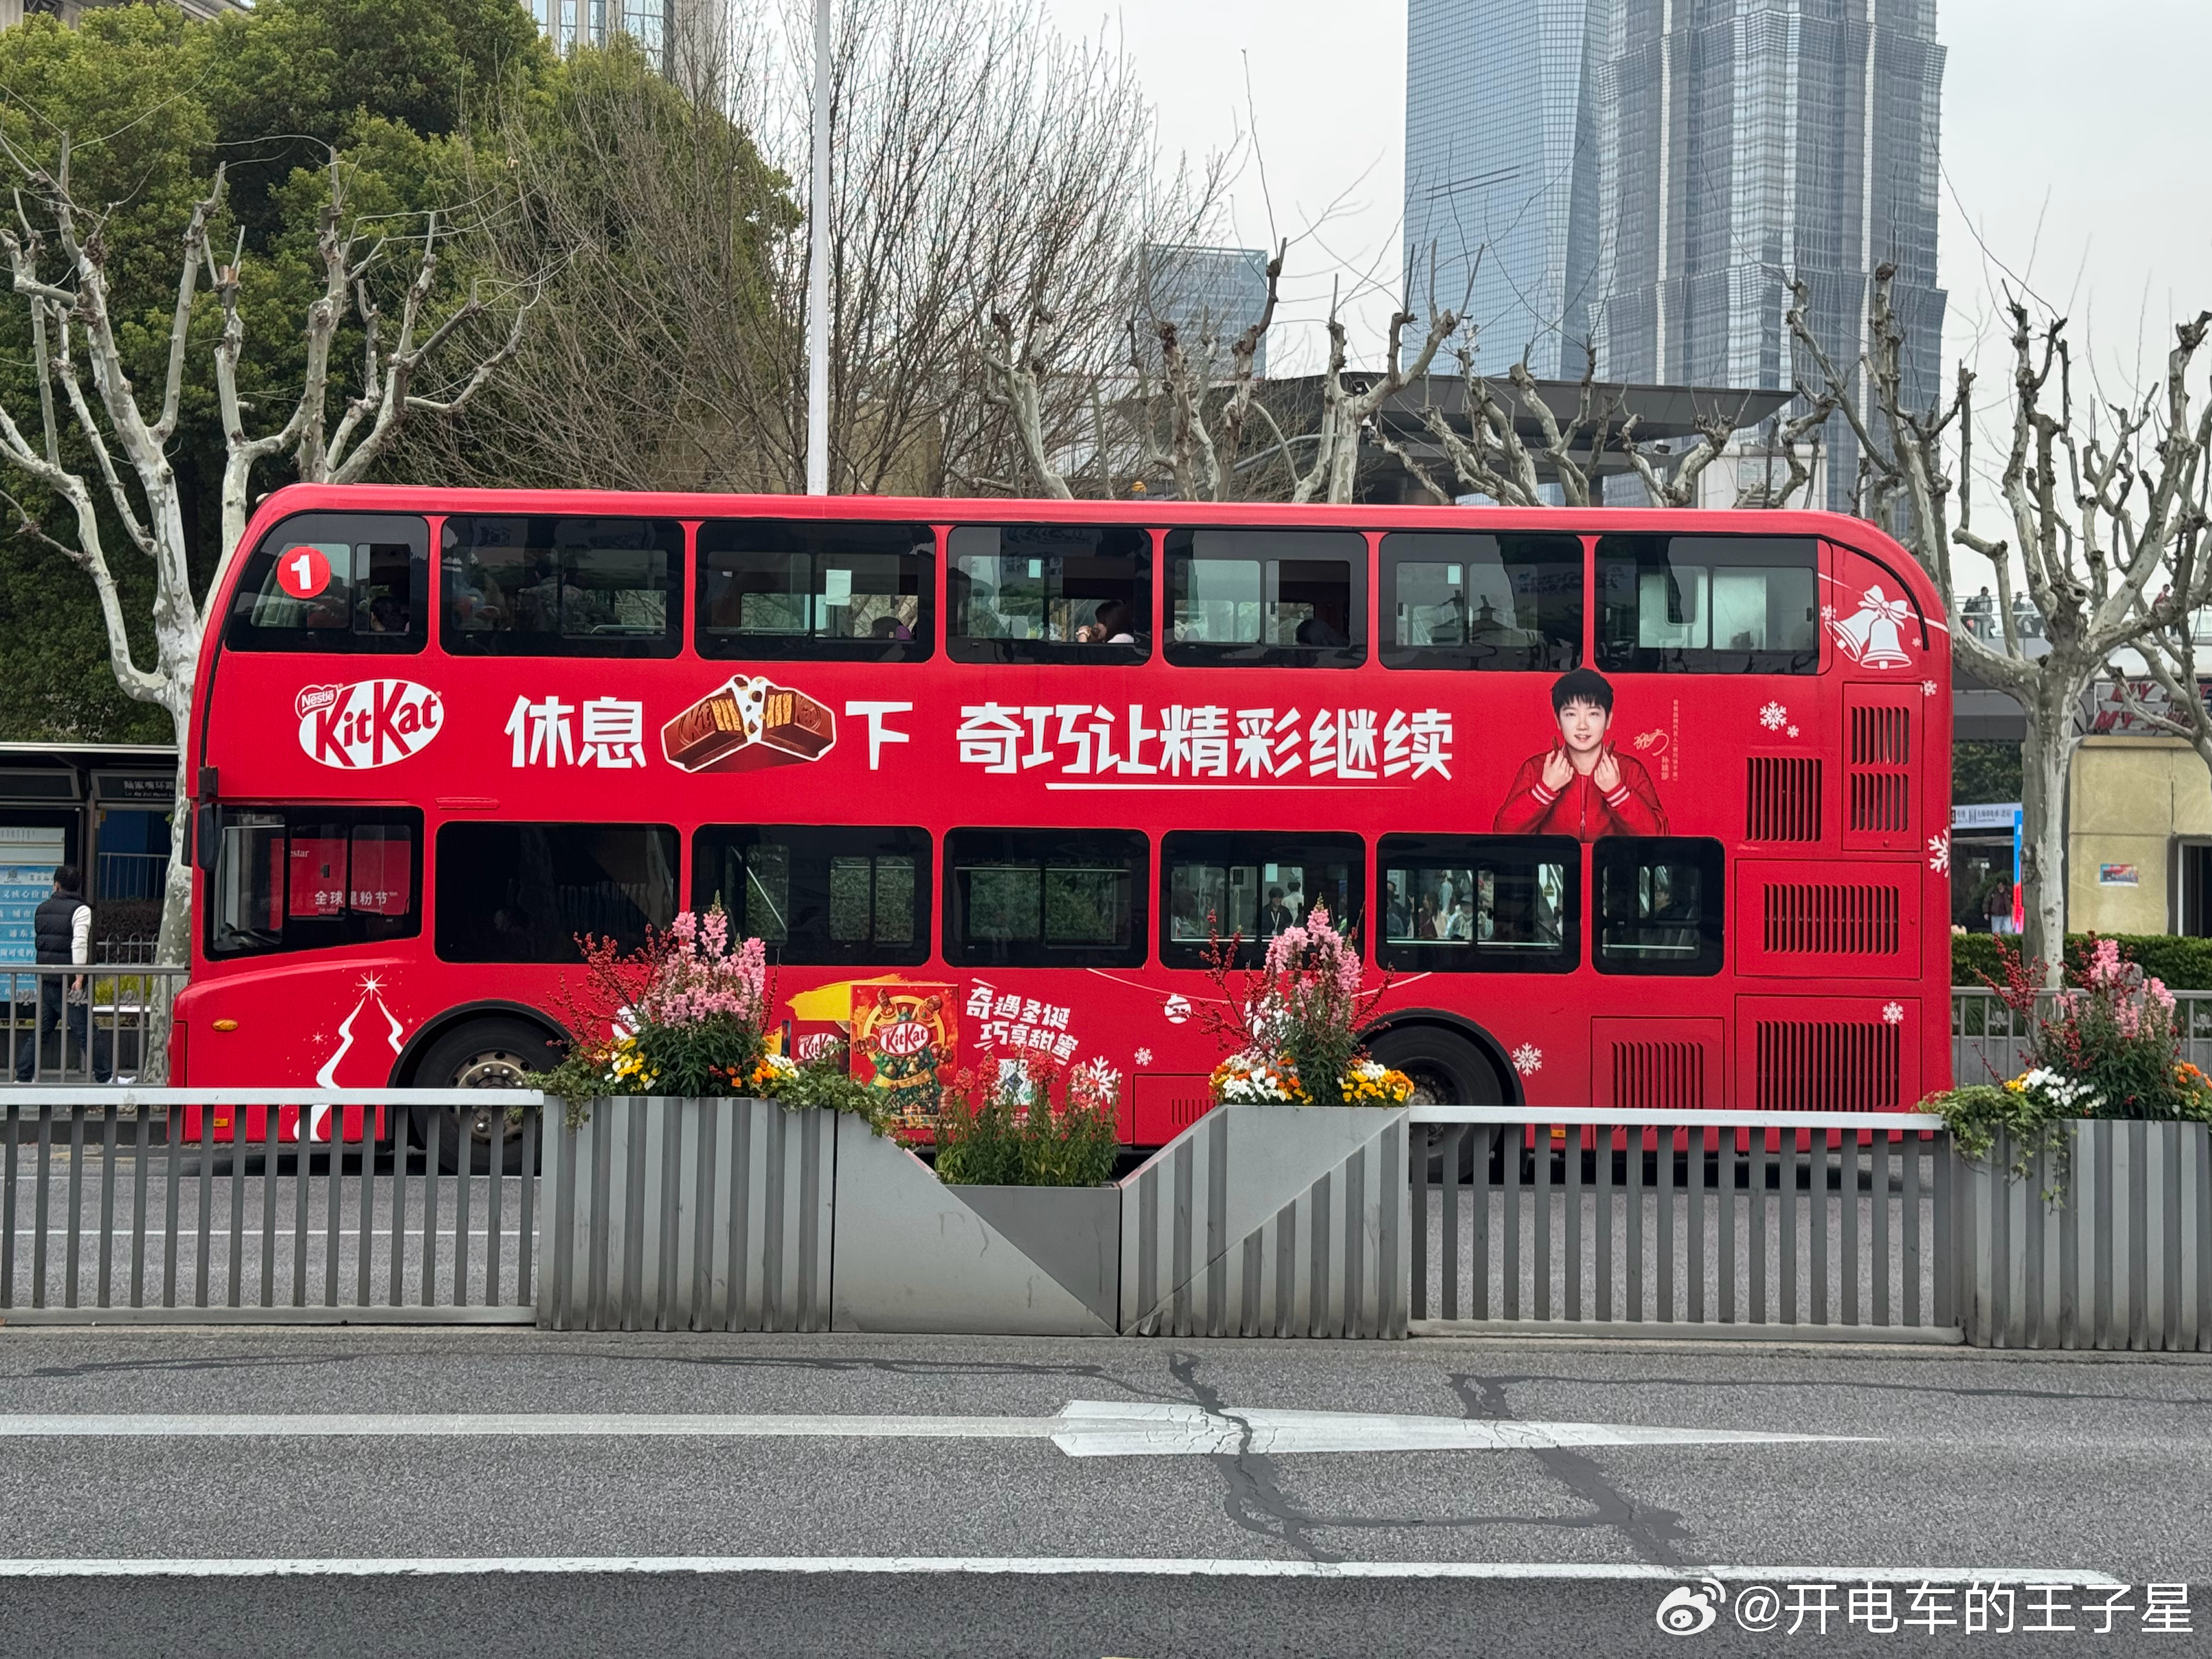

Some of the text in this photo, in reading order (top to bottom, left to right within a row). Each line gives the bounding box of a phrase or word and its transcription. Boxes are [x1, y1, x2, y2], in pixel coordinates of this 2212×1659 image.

[290, 555, 312, 590] 1
[315, 681, 437, 767] KitKat
[504, 695, 647, 768] 休息
[845, 702, 913, 770] 下
[956, 702, 1453, 781] 奇巧让精彩继续
[966, 986, 1070, 1031] 奇遇圣诞
[886, 1024, 926, 1053] KitKat
[980, 1020, 1079, 1060] 巧享甜蜜
